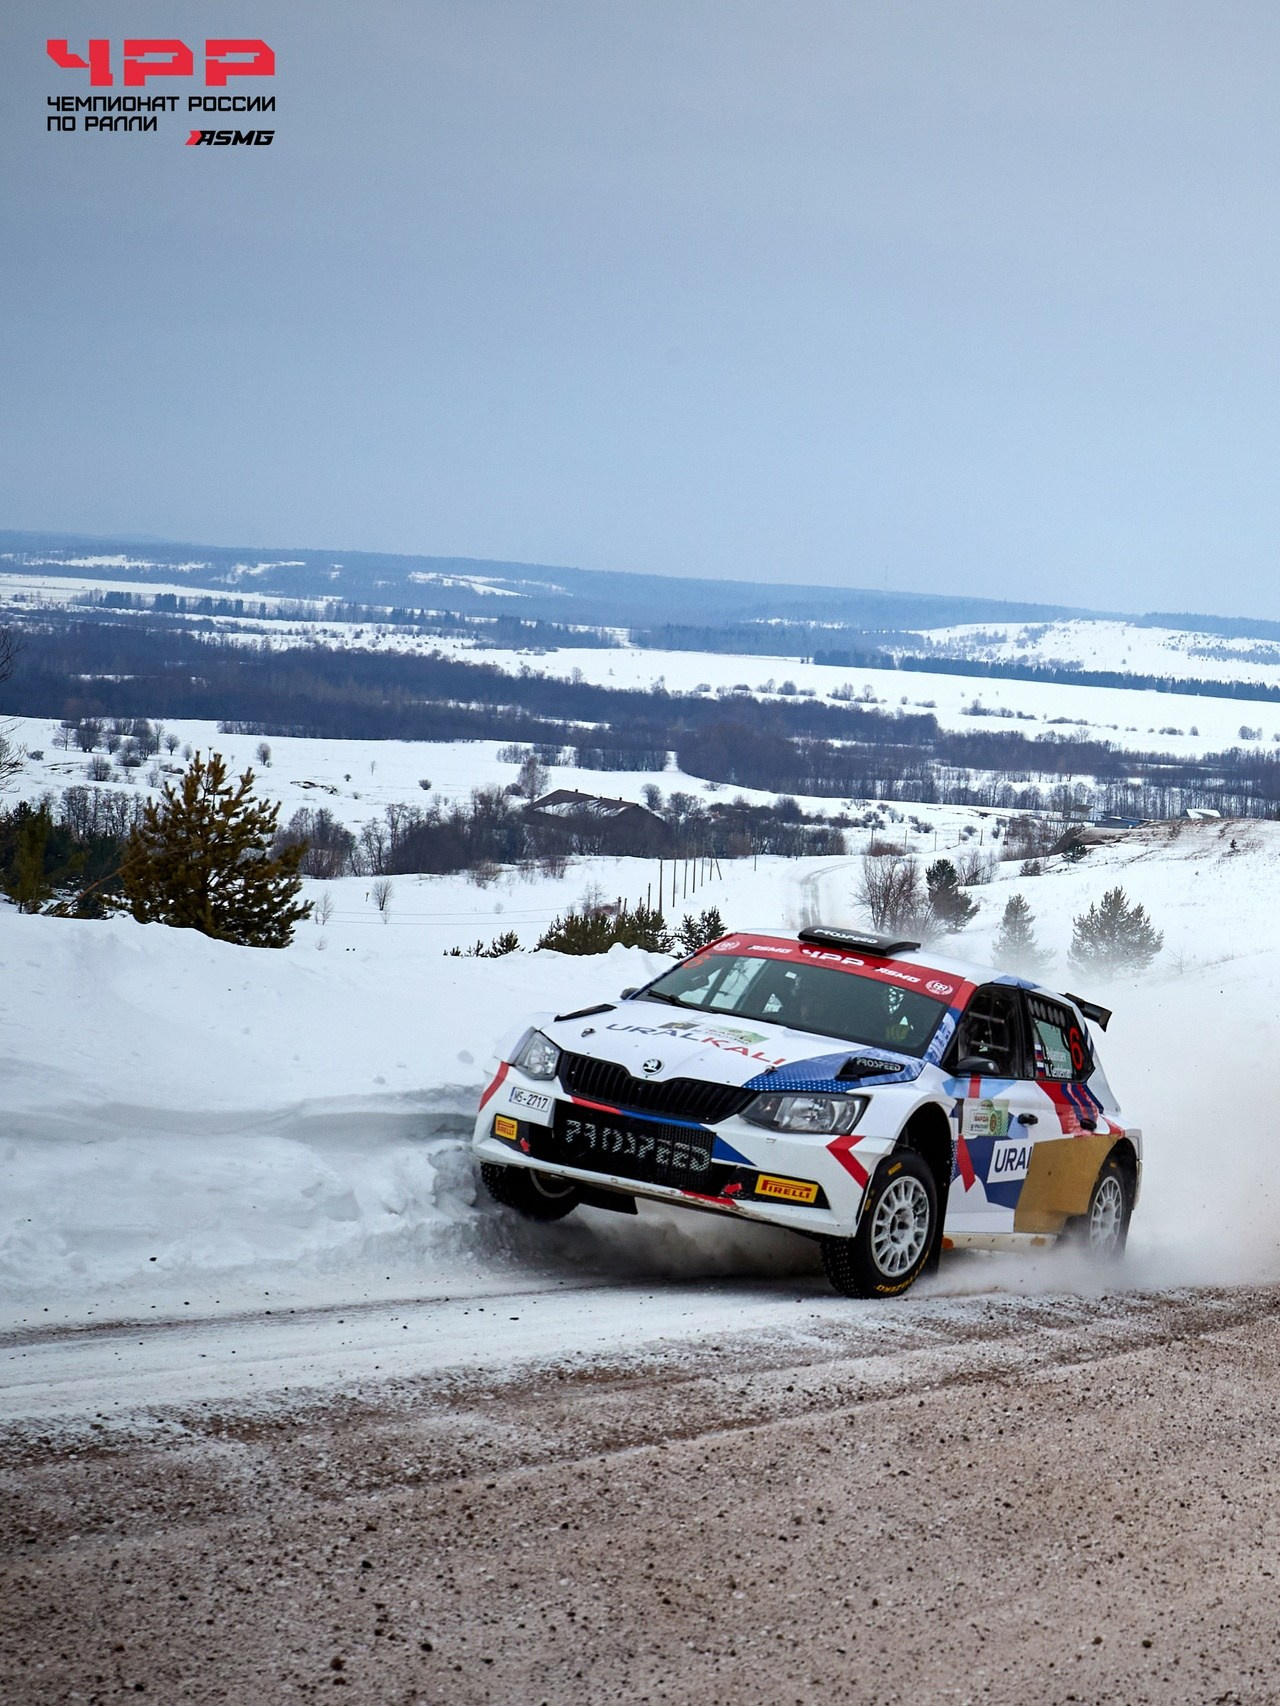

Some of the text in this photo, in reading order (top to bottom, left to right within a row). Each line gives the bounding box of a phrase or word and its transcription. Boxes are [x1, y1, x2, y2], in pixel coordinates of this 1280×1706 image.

[606, 1023, 787, 1066] URALKALI
[1069, 1026, 1084, 1071] 6
[856, 1057, 901, 1072] PROSPEED
[761, 1179, 812, 1200] PIRELLI
